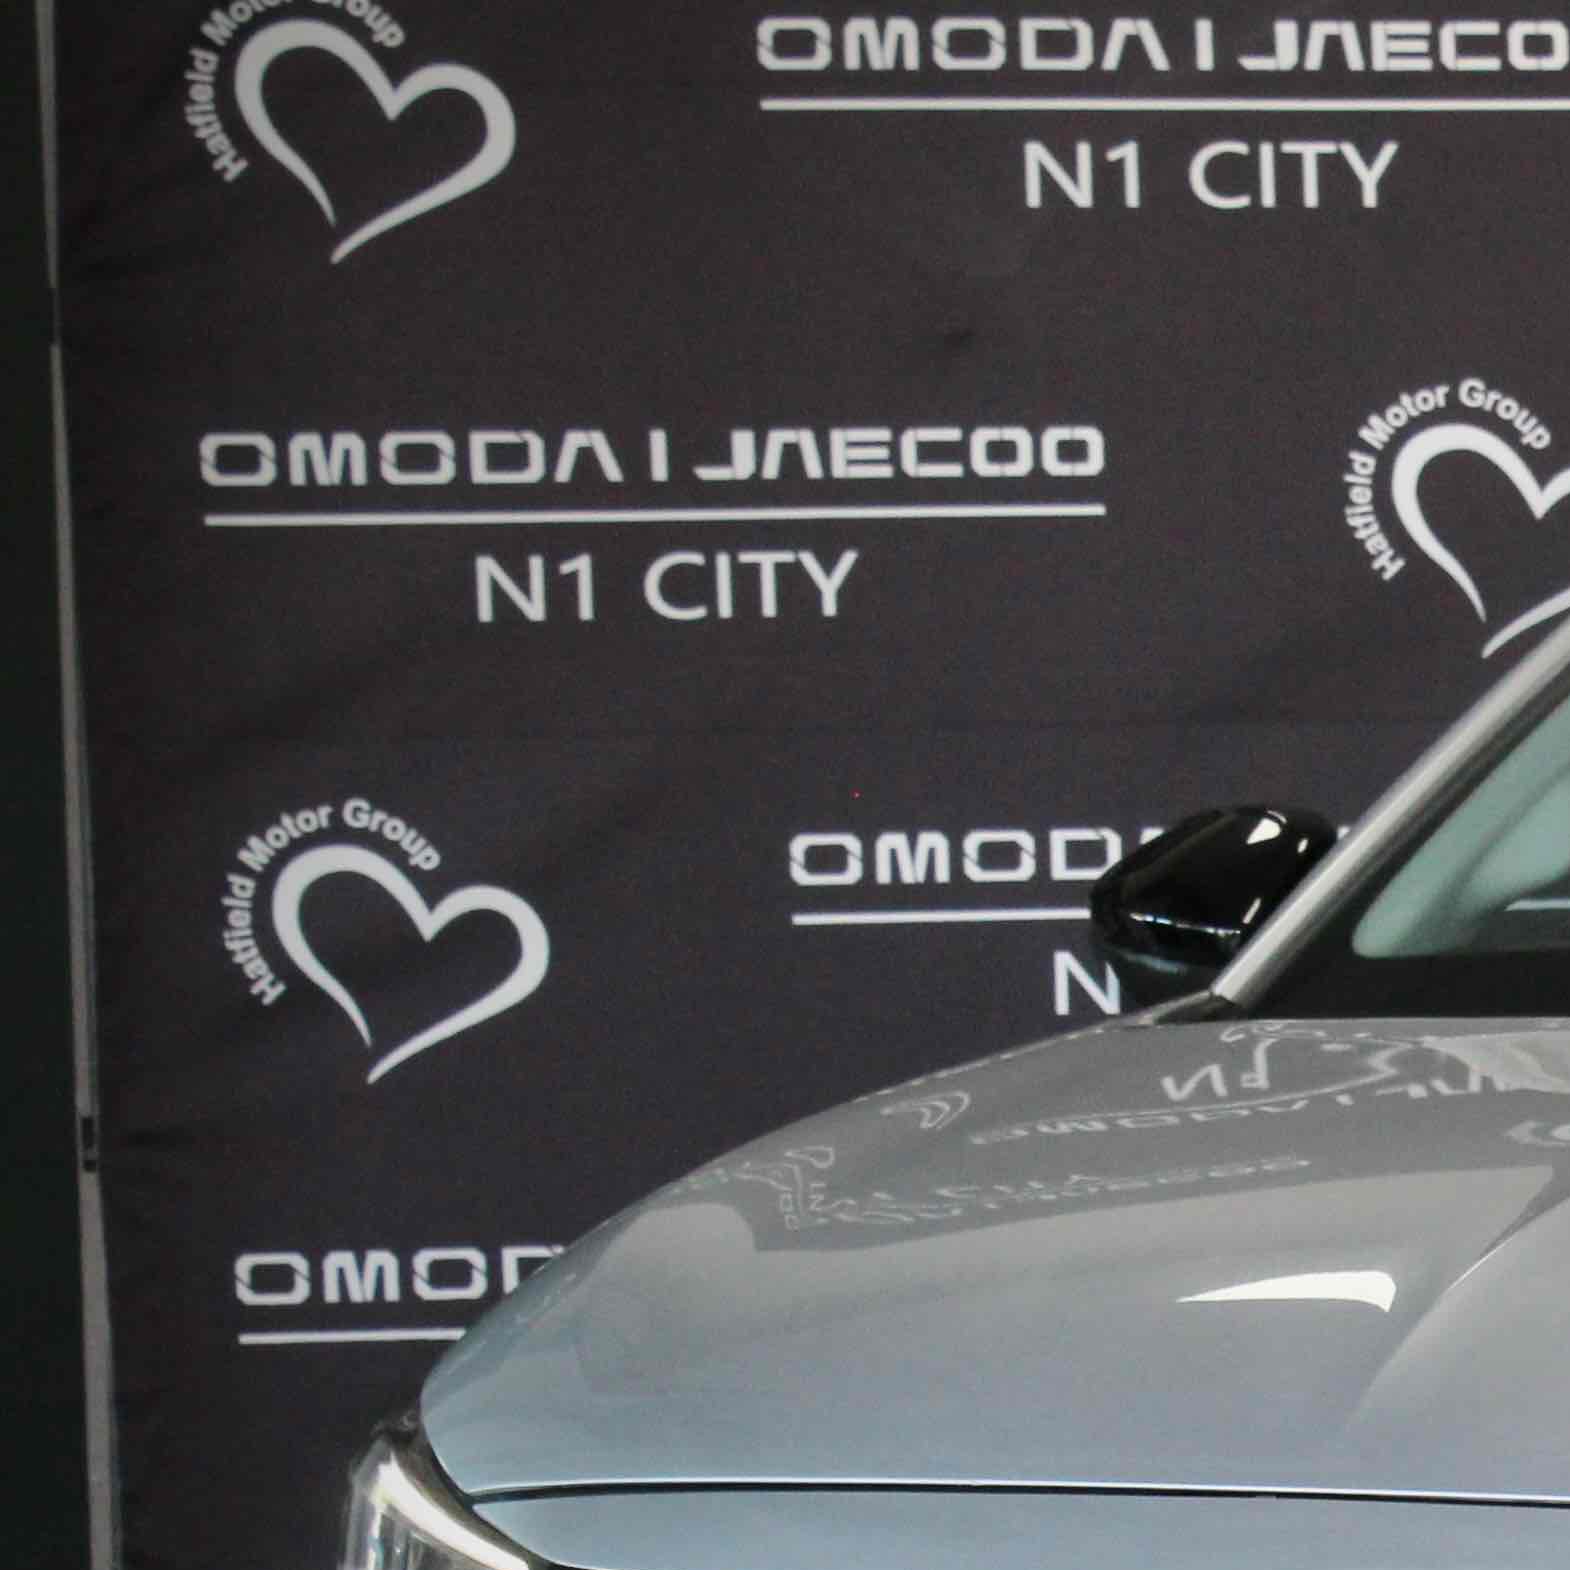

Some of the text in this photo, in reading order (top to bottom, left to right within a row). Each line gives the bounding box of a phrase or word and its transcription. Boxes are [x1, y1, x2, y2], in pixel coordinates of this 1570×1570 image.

[757, 17, 1170, 71] OMODA
[184, 0, 405, 182] Hatfield Mot oup
[1024, 140, 1398, 209] N1 CITY
[200, 430, 623, 486] OMODA
[695, 425, 1105, 480] JAECOO
[1343, 376, 1552, 582] Hatfield Motor Group
[475, 550, 858, 623] N1 CITY
[788, 826, 1166, 887] OMOD
[221, 796, 442, 1006] Hatfield Motor Group
[232, 1245, 566, 1308] OMO
